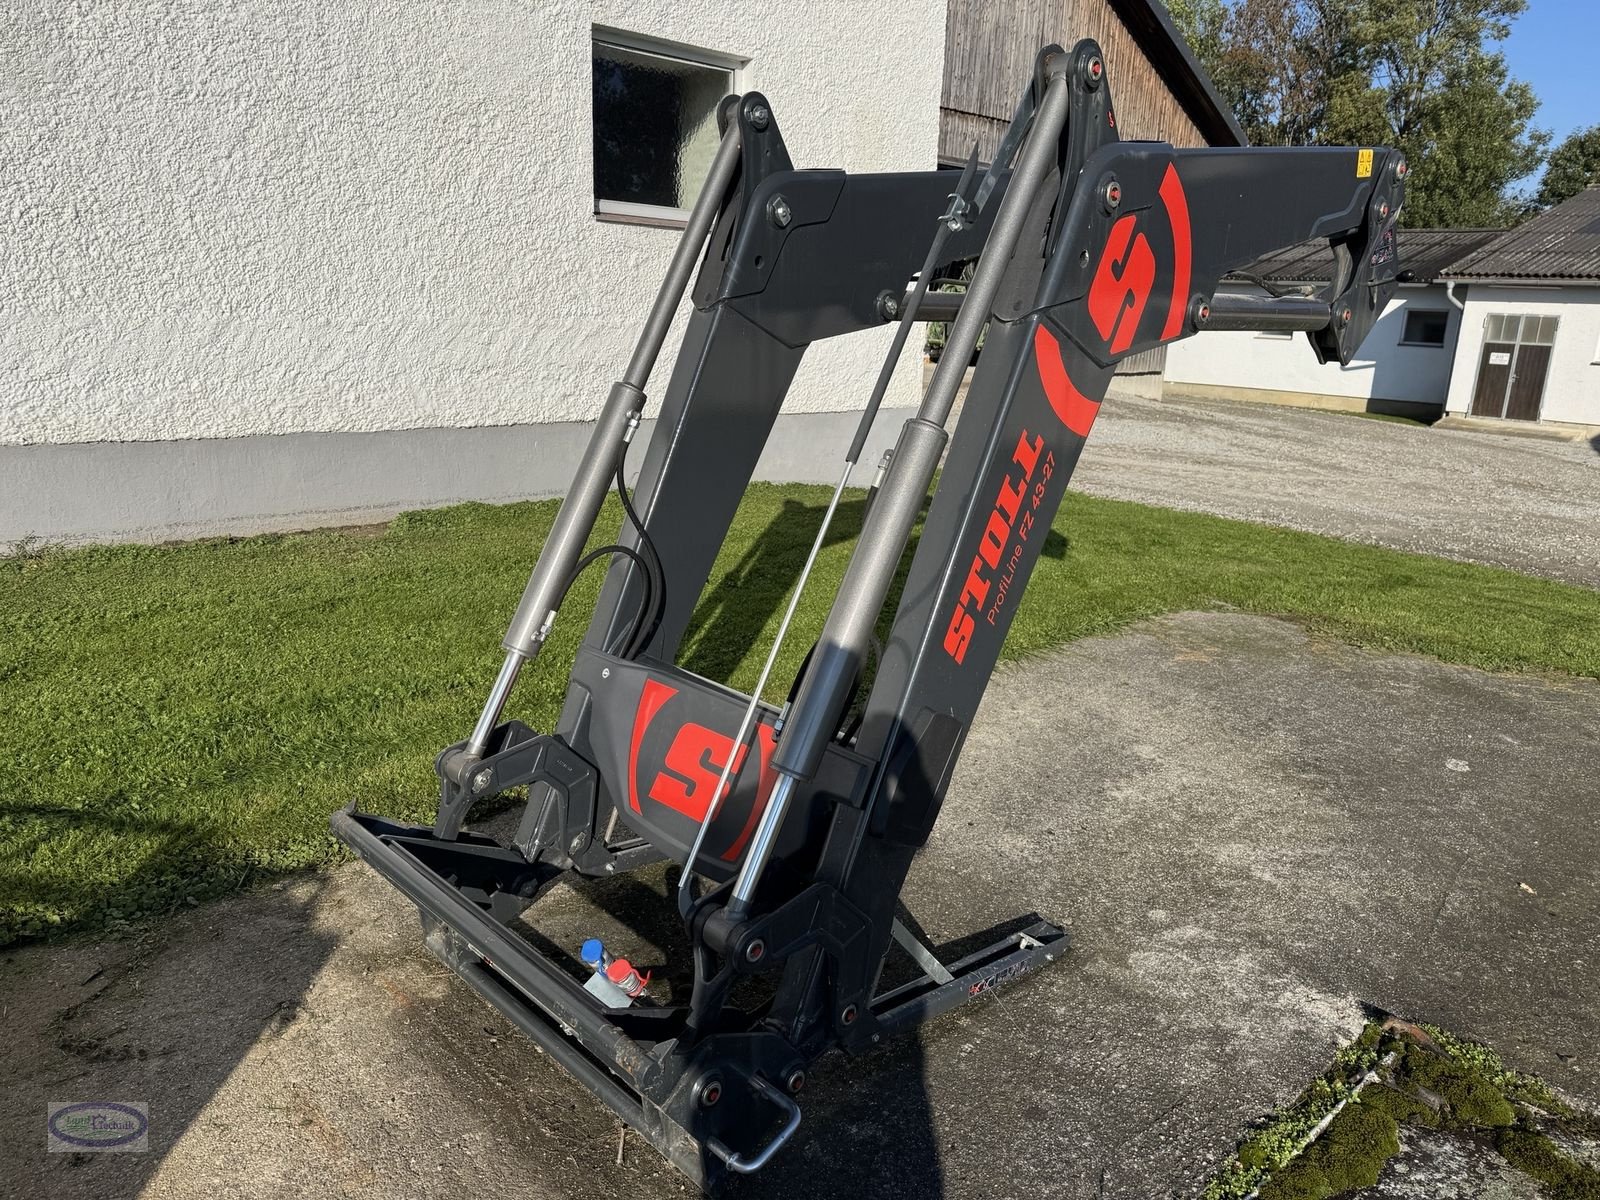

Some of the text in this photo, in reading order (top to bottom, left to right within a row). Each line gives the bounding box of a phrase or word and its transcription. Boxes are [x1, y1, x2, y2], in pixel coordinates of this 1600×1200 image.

[1088, 214, 1156, 355] S
[943, 428, 1045, 665] STOLL
[987, 451, 1056, 626] ProfiLine FZ 43-27
[648, 722, 749, 824] S
